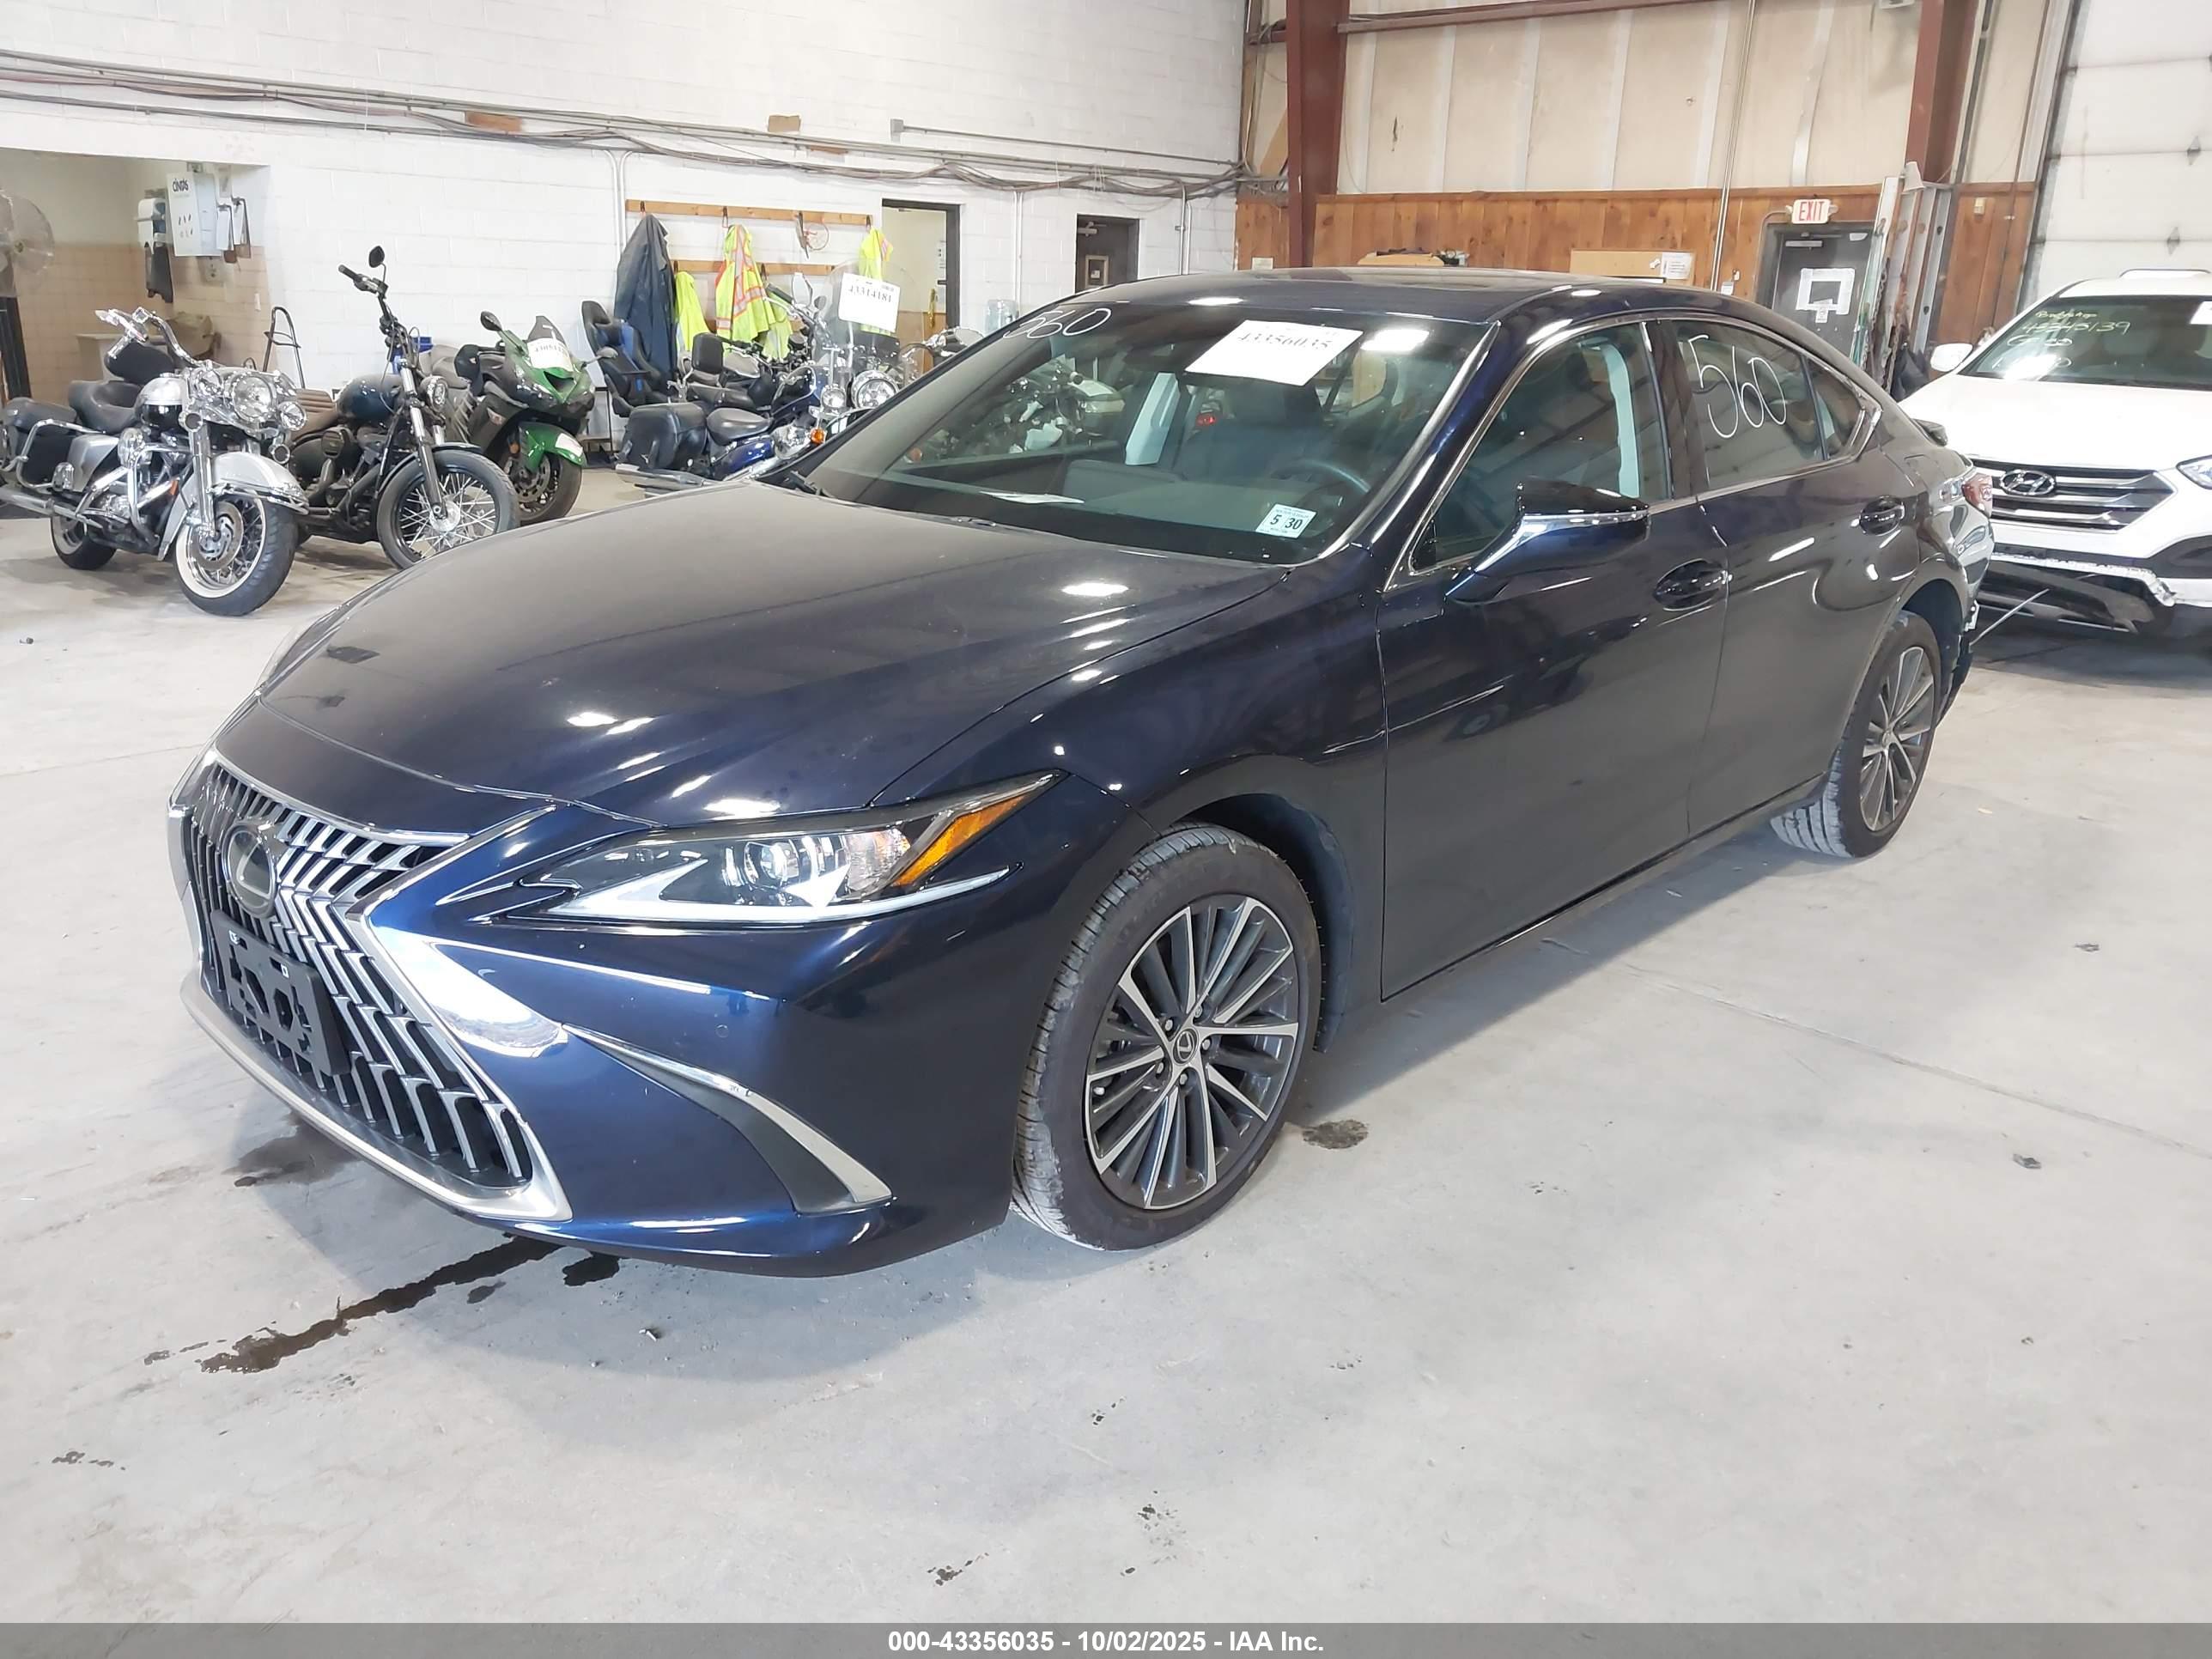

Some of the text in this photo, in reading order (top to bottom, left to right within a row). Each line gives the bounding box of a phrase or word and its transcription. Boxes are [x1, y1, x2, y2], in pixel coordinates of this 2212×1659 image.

[1799, 201, 1825, 221] EXIT
[1003, 307, 1111, 338] 560
[1237, 332, 1333, 350] 43356035
[1687, 334, 1787, 439] 560
[1270, 514, 1303, 530] 5 30
